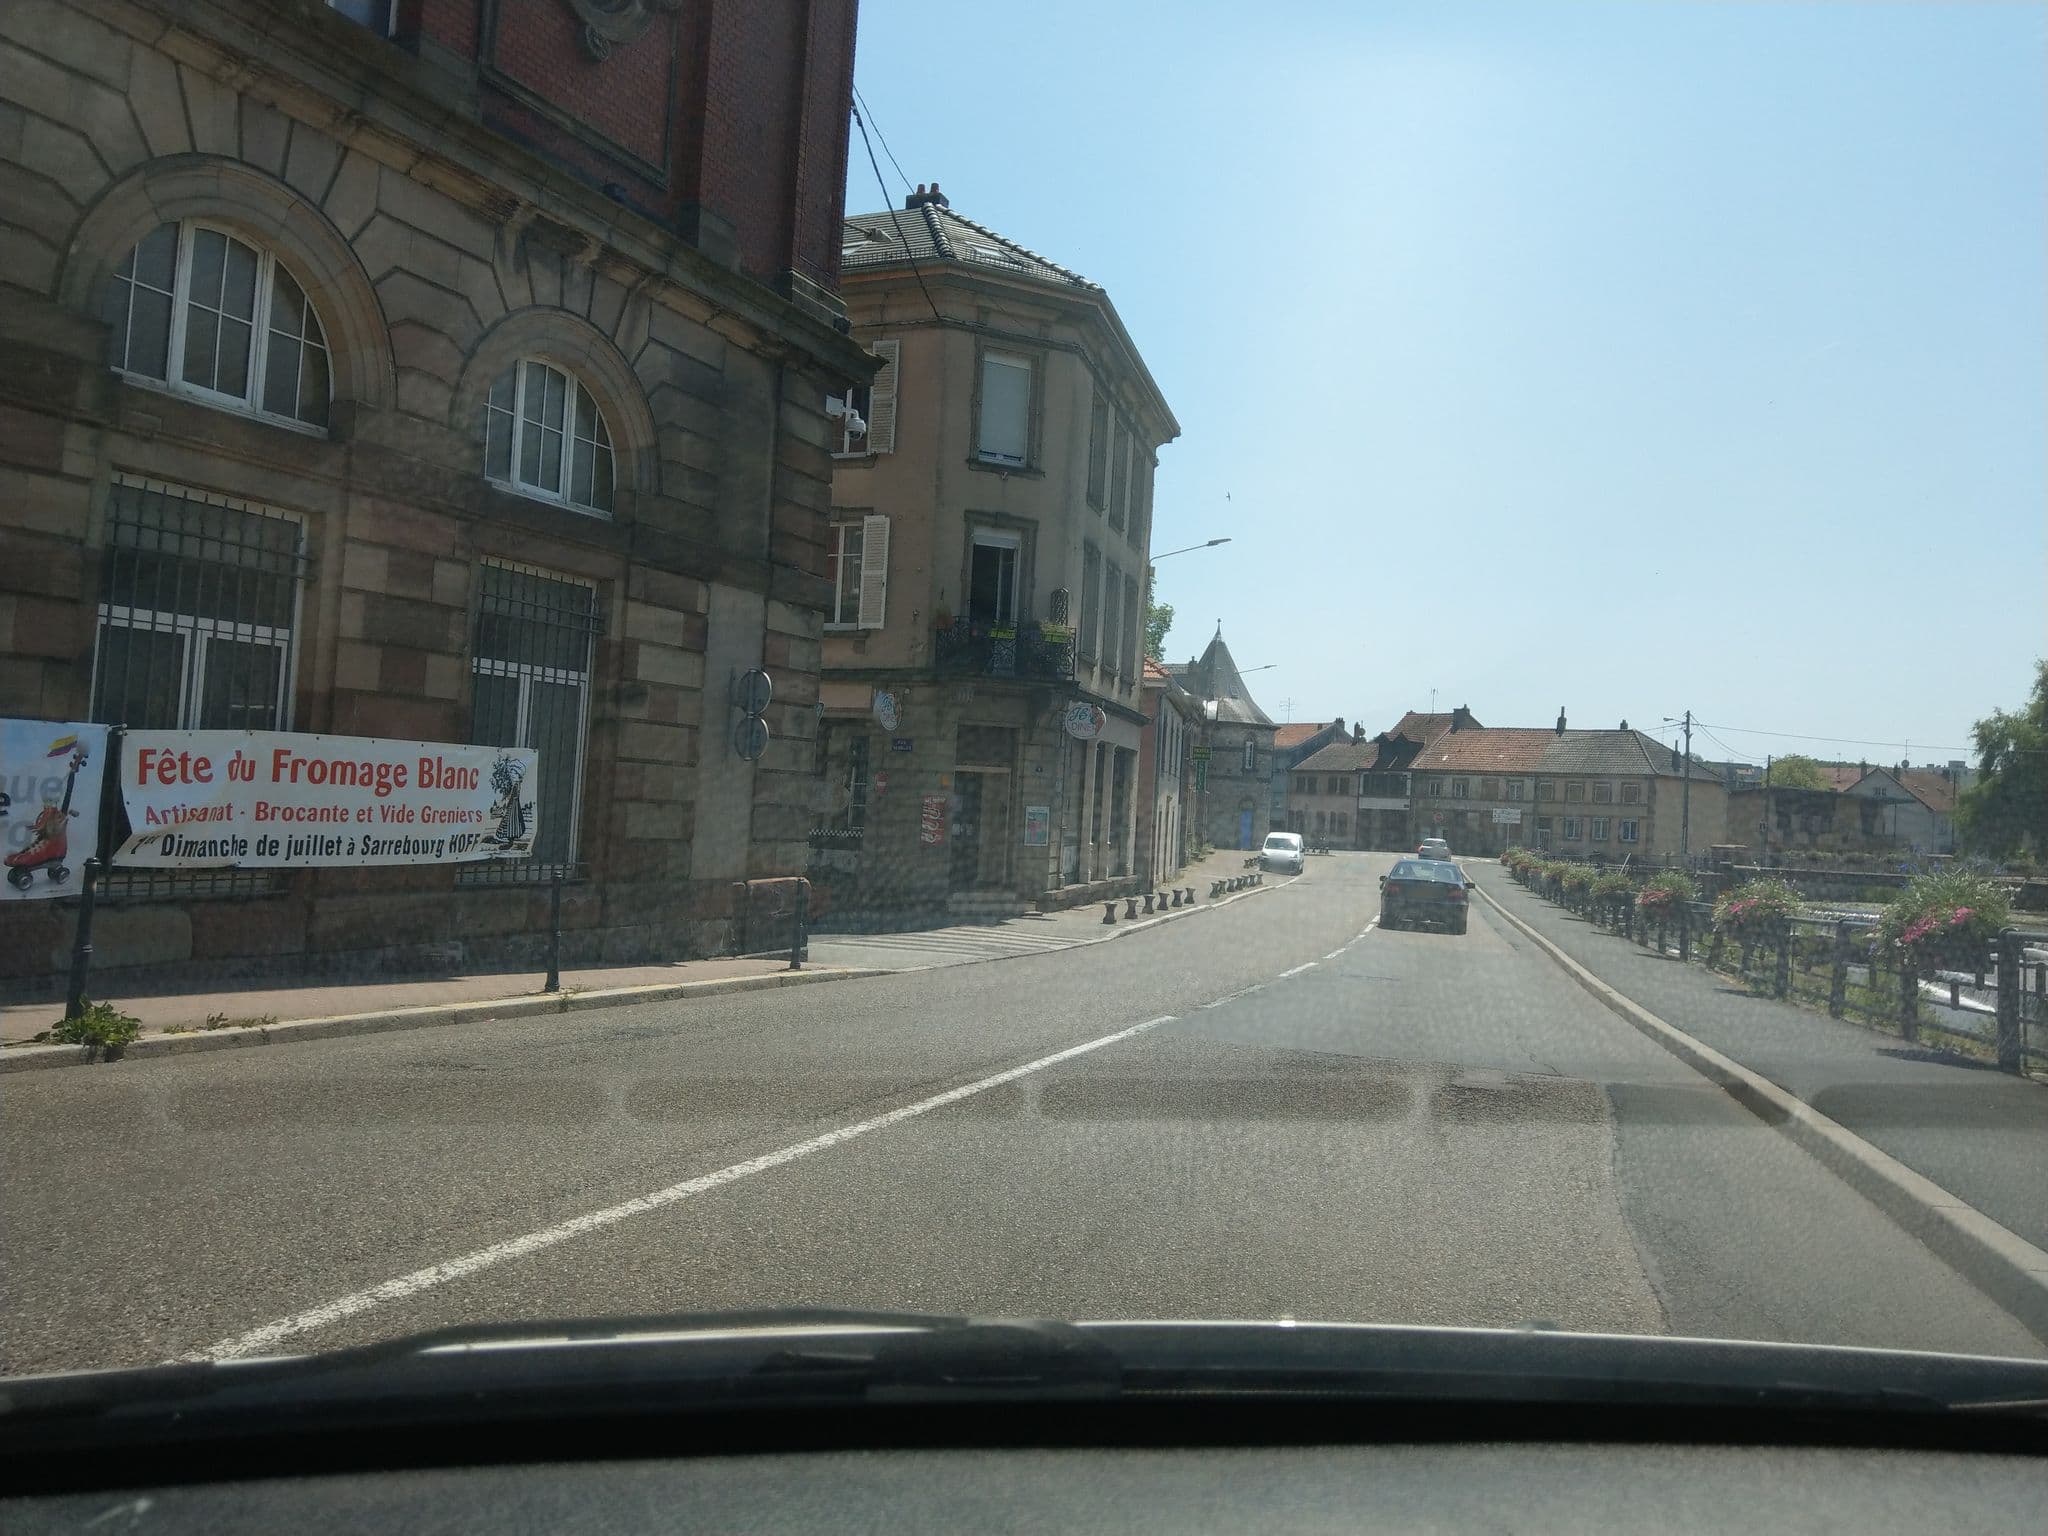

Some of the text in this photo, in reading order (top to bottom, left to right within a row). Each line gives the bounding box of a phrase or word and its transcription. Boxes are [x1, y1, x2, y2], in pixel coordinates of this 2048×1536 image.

[138, 748, 479, 797] Fête du Fromage Blanc
[145, 801, 483, 825] Artisanat Brocante et Vide Greniers
[160, 833, 249, 858] Dimanche
[256, 834, 280, 857] de
[285, 834, 342, 861] juillet
[346, 837, 355, 856] à
[361, 834, 445, 859] Sarrebourg
[449, 833, 481, 854] HOFF
